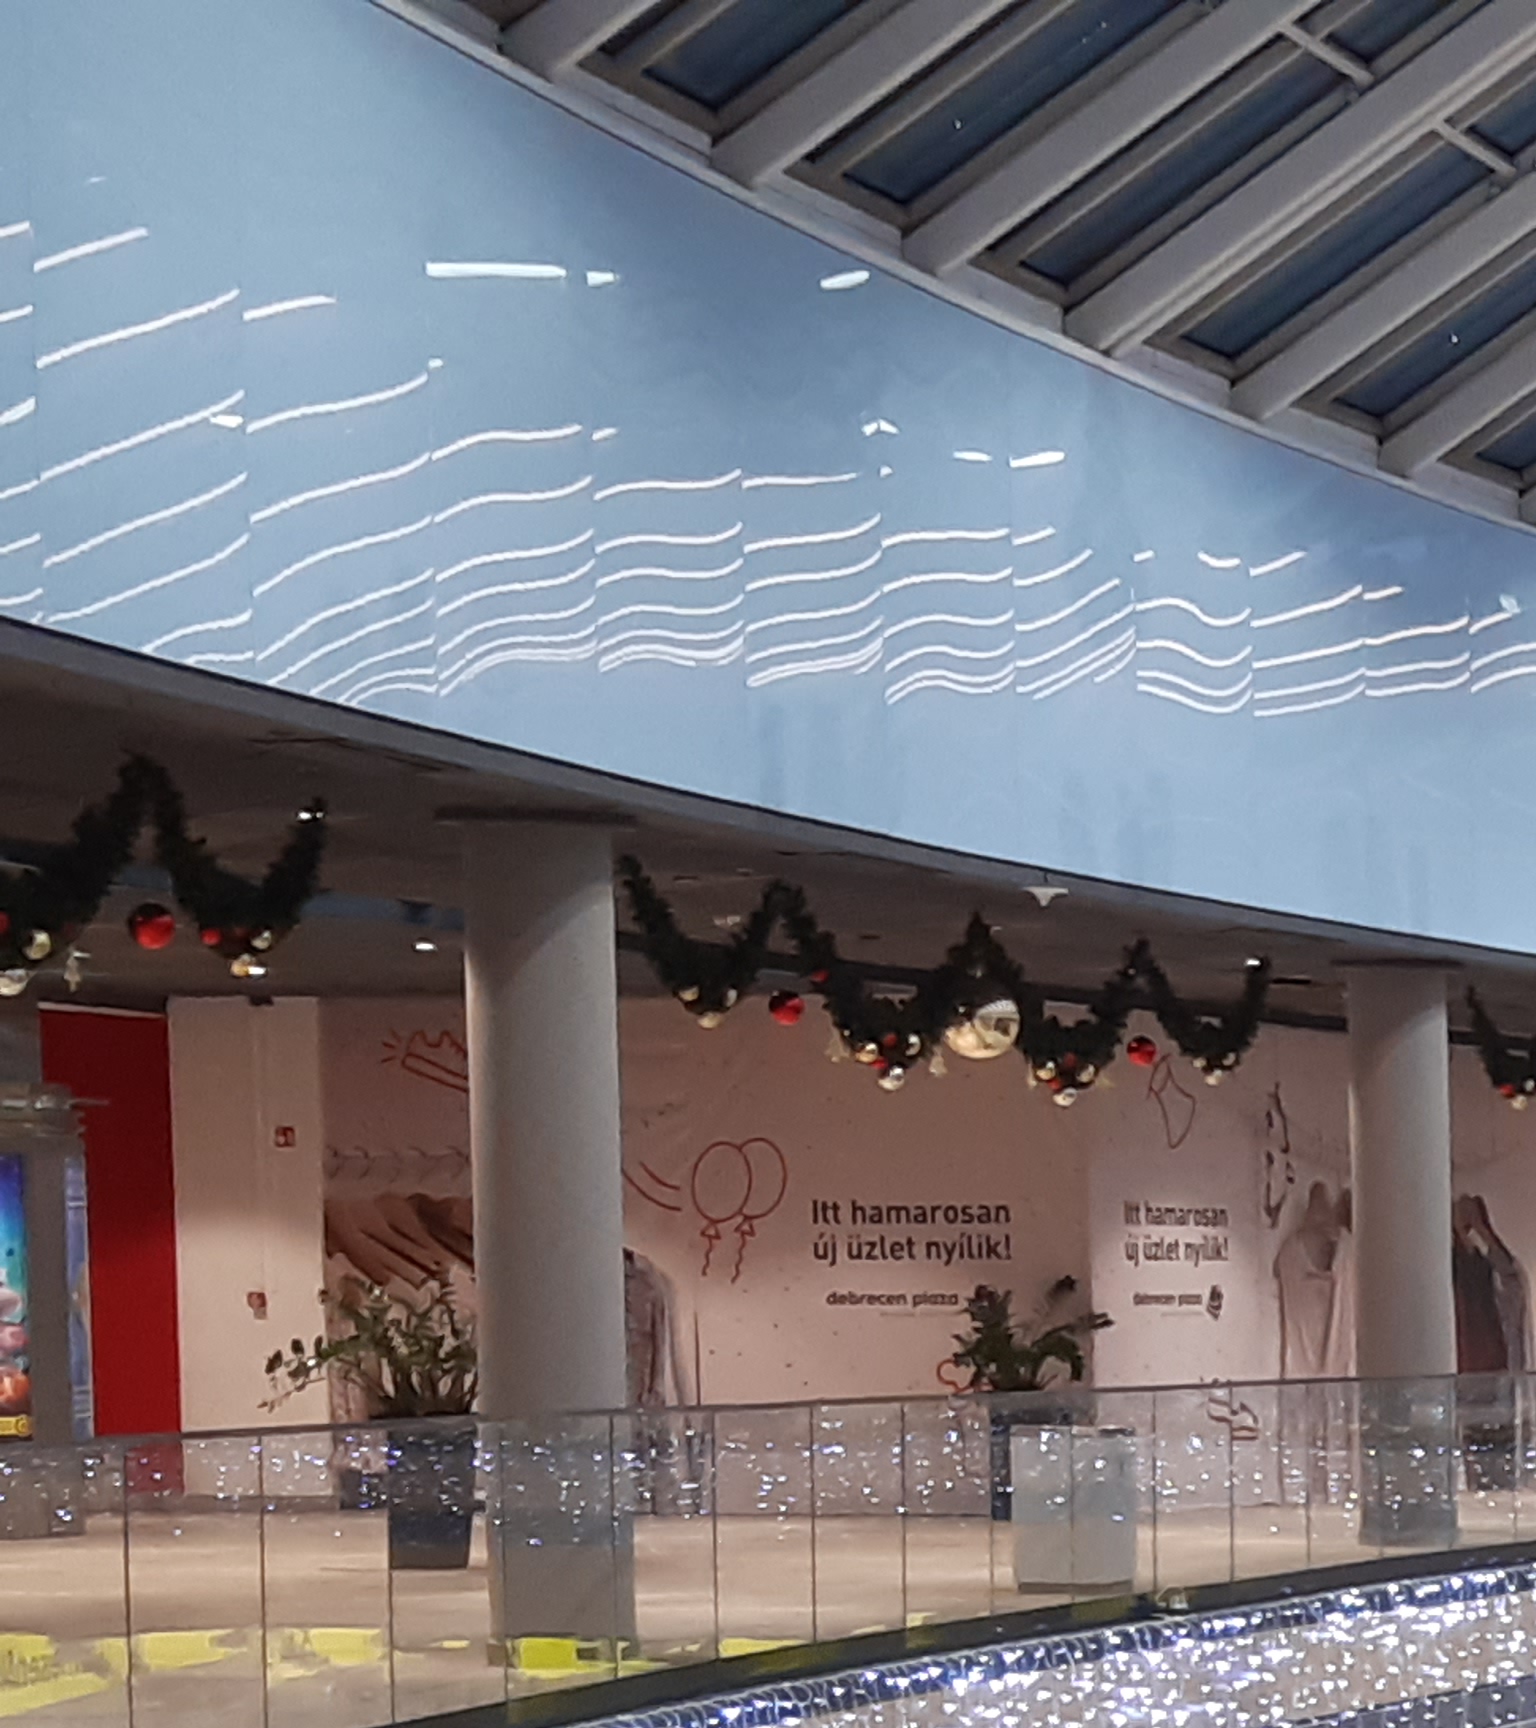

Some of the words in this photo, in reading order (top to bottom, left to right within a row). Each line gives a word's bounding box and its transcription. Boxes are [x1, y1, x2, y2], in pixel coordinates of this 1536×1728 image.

[811, 1200, 841, 1225] Itt
[851, 1200, 1011, 1225] hamarosan
[813, 1233, 837, 1267] új
[847, 1234, 916, 1260] üzlet
[925, 1232, 1012, 1267] nyílik!
[825, 1291, 907, 1306] debrecen
